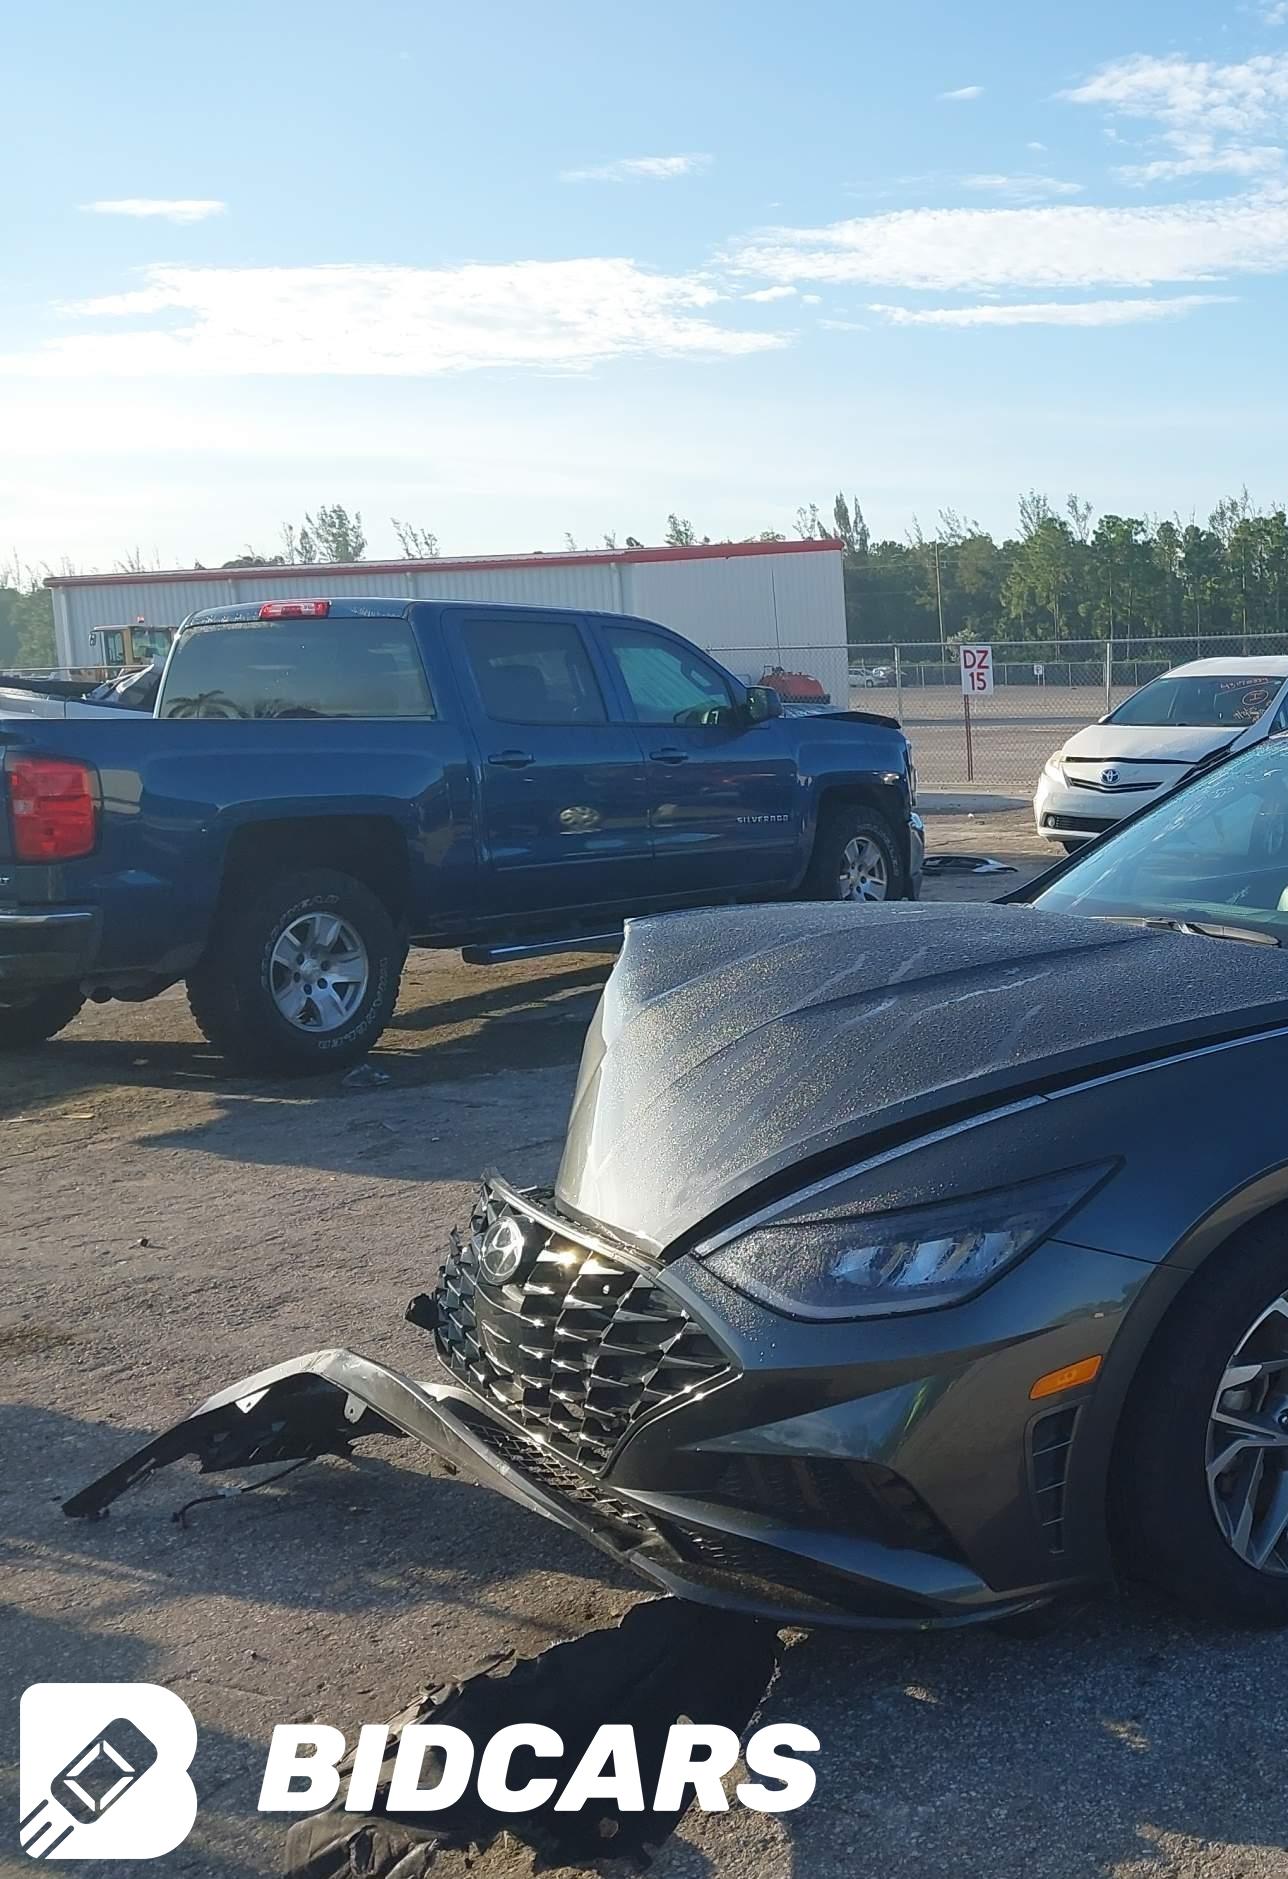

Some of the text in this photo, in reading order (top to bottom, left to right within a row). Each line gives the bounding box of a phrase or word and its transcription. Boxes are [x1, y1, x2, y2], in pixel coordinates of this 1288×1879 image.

[962, 649, 990, 669] DZ
[969, 671, 987, 691] 15
[736, 814, 789, 824] SILVERADO
